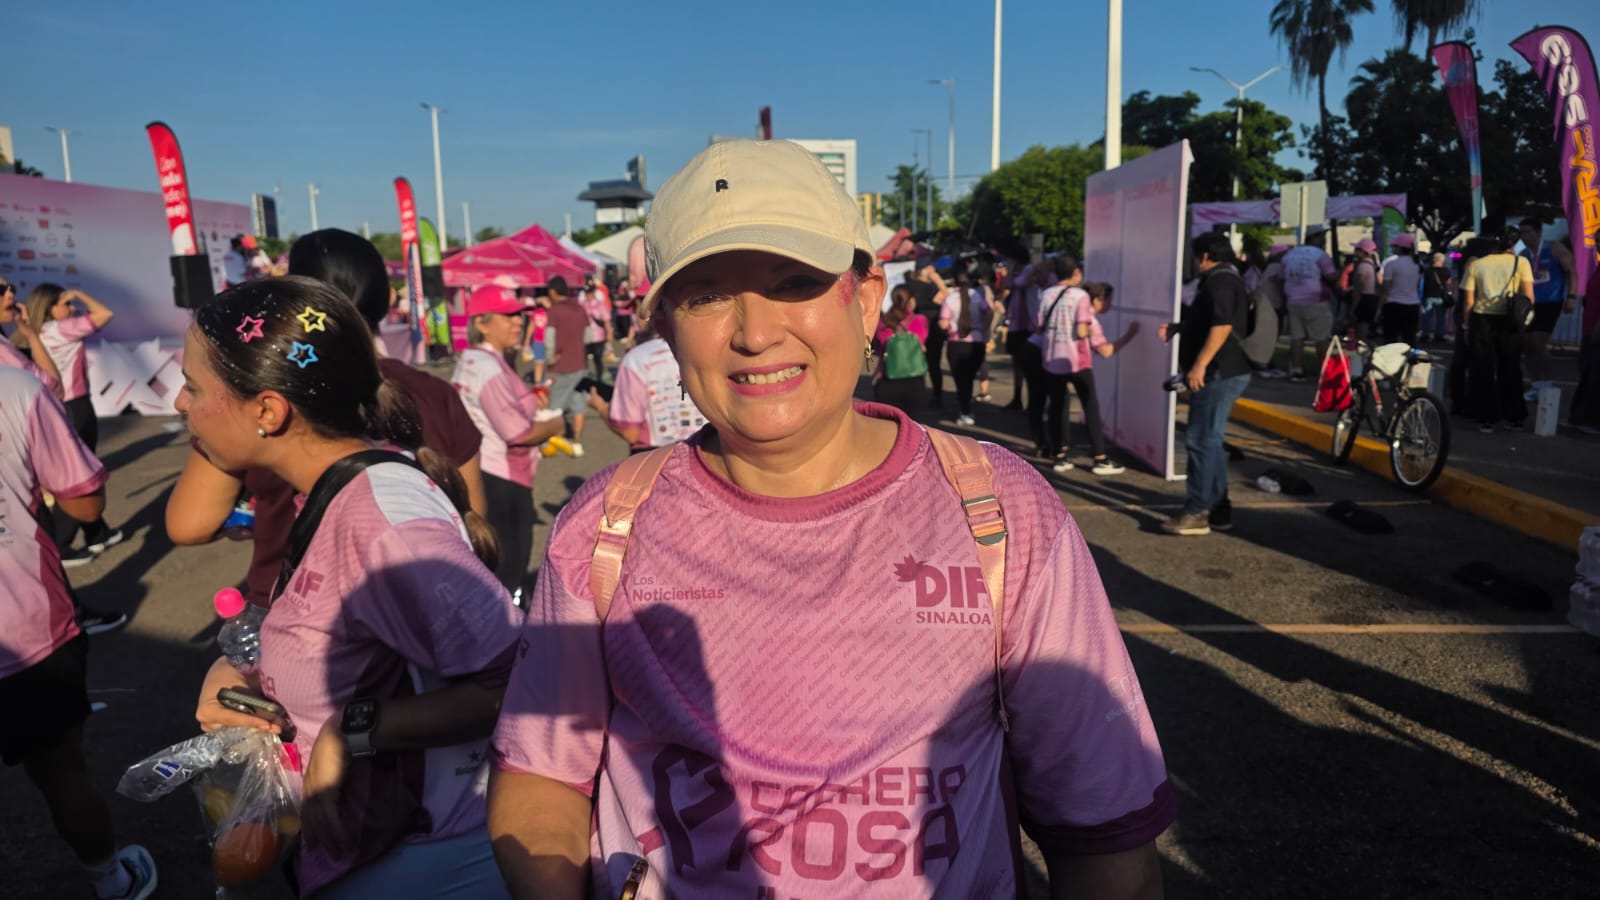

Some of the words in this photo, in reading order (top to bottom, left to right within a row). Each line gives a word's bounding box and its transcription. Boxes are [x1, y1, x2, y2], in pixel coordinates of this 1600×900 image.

[633, 576, 655, 586] Los
[632, 586, 725, 601] Noticieristas
[916, 611, 991, 625] SINALOA
[726, 805, 961, 882] ROSA
